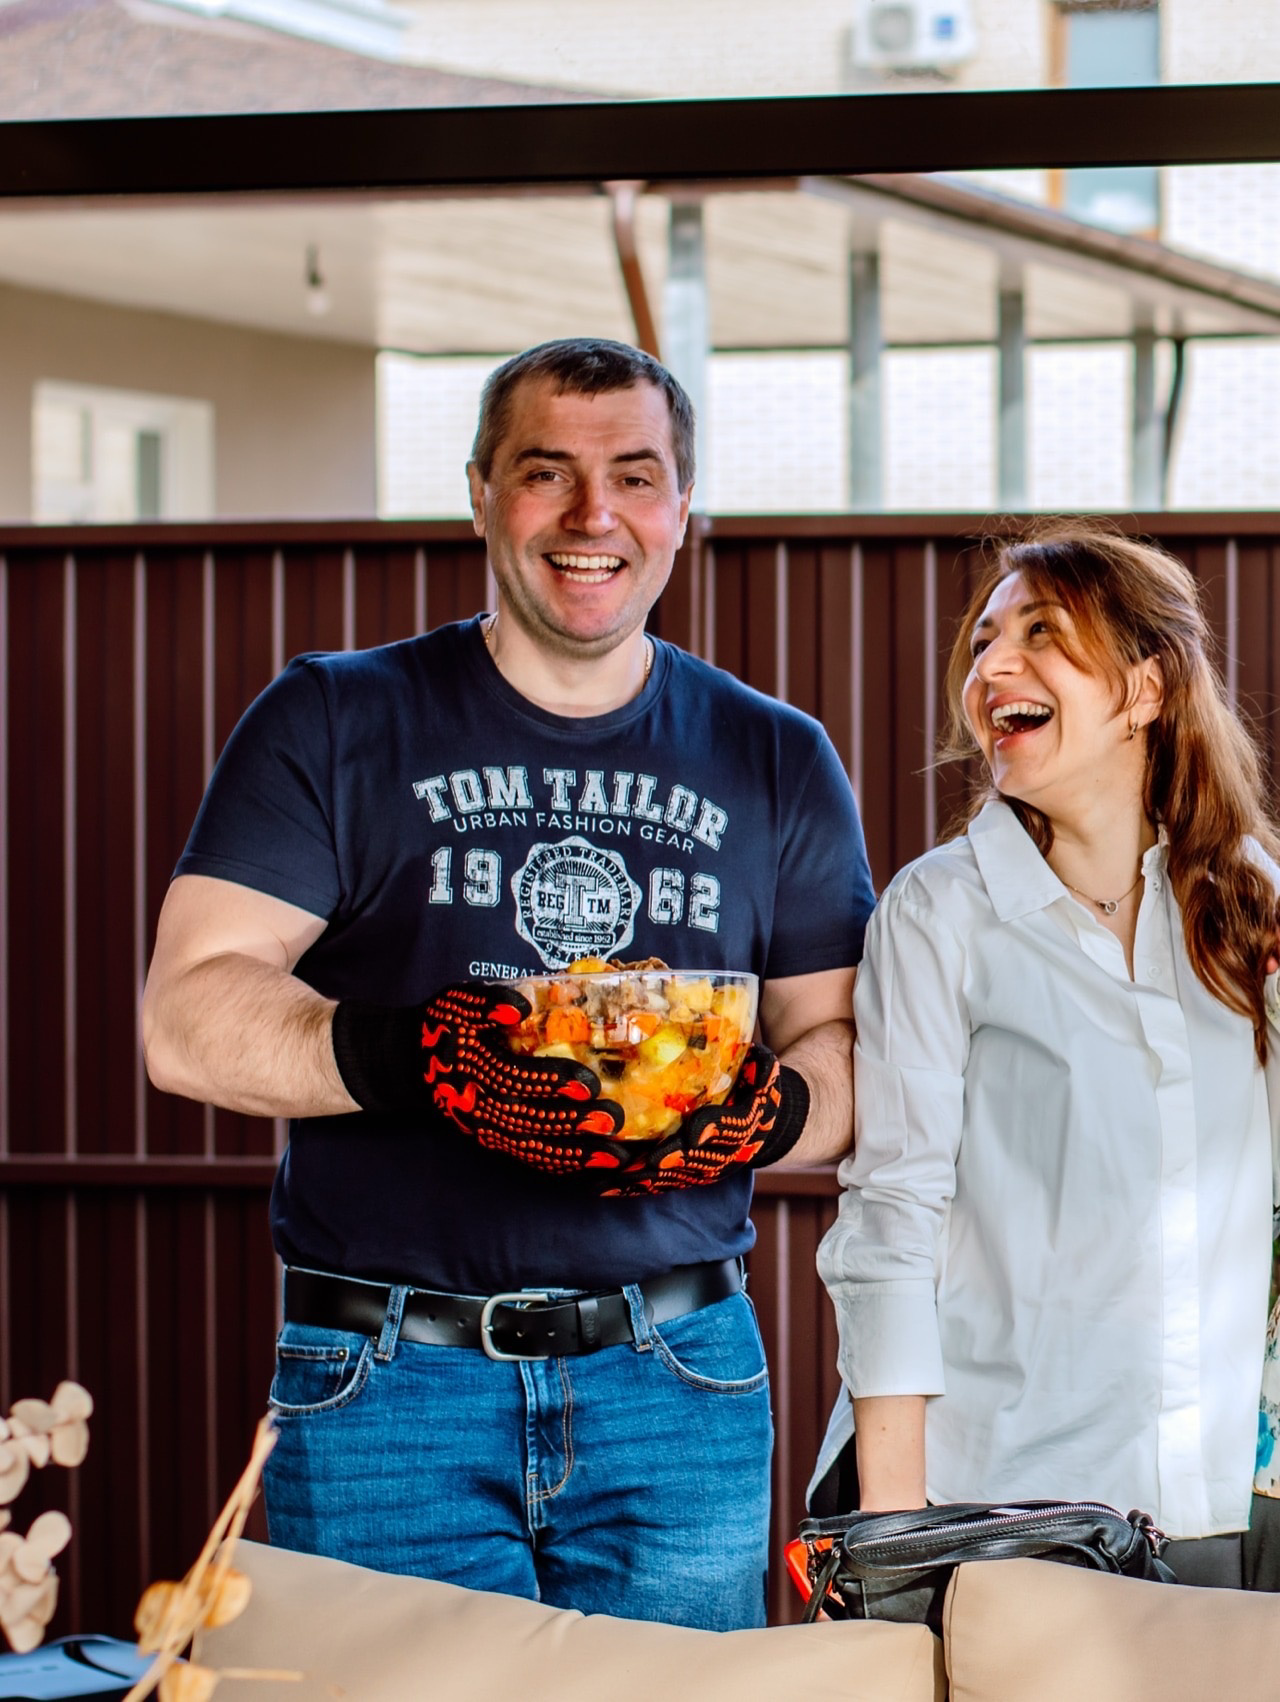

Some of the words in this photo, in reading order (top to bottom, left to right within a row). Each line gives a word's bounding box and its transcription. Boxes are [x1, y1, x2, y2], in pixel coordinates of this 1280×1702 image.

[412, 765, 534, 823] TOM
[543, 768, 729, 851] TAILOR
[453, 811, 527, 833] URBAN
[535, 812, 631, 836] FASHION
[640, 824, 694, 855] GEAR
[429, 846, 501, 907] 19
[648, 867, 721, 933] 62
[520, 846, 572, 919] REGISTERED
[579, 848, 632, 928] TRADEMARK
[537, 890, 565, 910] REG
[587, 898, 611, 914] TM
[574, 932, 593, 942] since
